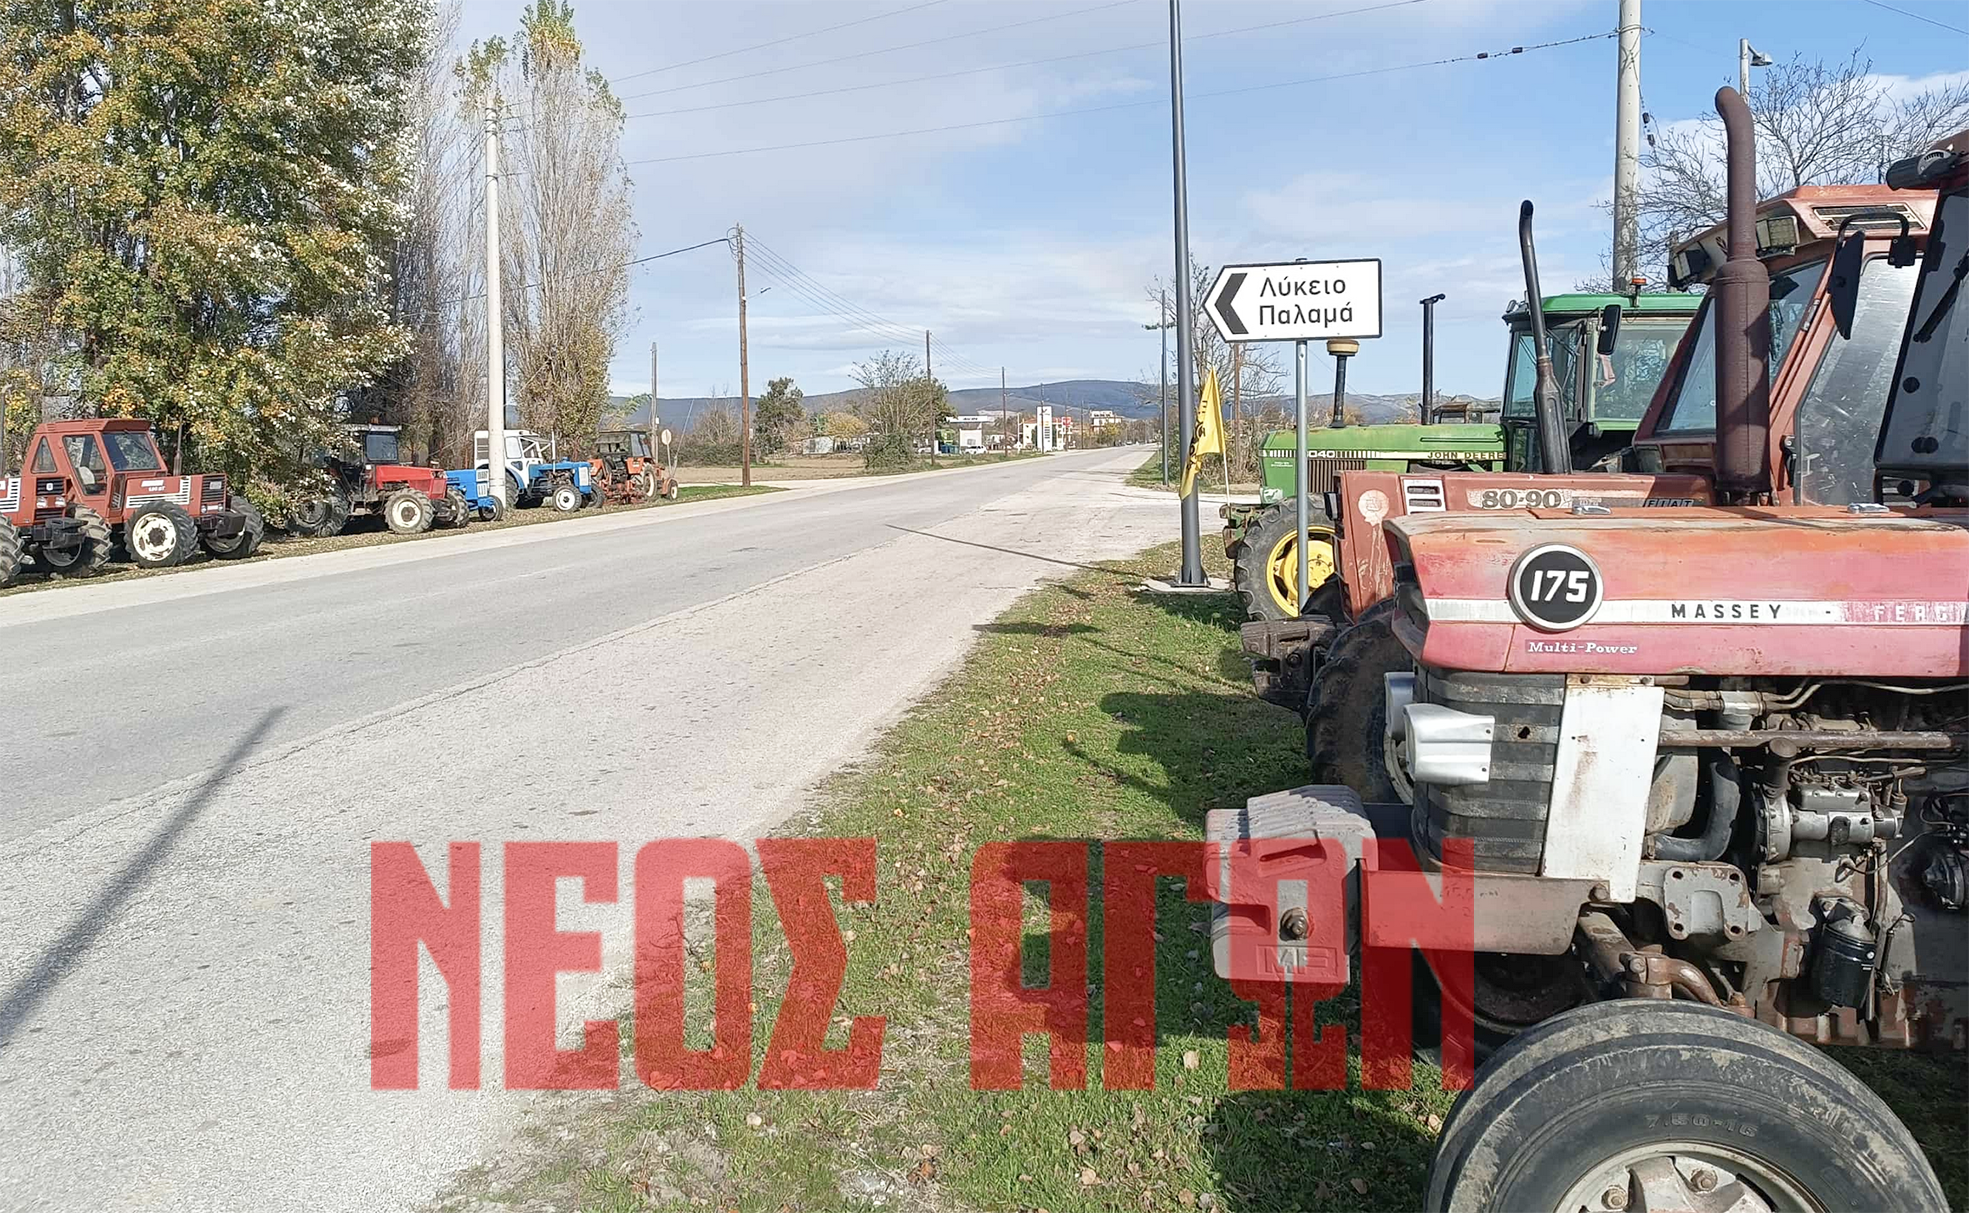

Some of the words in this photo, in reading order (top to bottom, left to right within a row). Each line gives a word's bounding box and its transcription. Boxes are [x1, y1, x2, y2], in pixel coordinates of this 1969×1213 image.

[1260, 276, 1346, 297] Λύκειο
[1259, 302, 1353, 328] Παλαμά
[1305, 450, 1336, 458] 040
[1427, 451, 1458, 459] JOHN
[1464, 451, 1507, 459] DEERE
[1481, 490, 1562, 508] 80-90
[1646, 498, 1694, 508] FIAT
[1530, 570, 1590, 603] 175
[1671, 604, 1782, 619] MASSEY
[1527, 642, 1638, 654] Multi-Power
